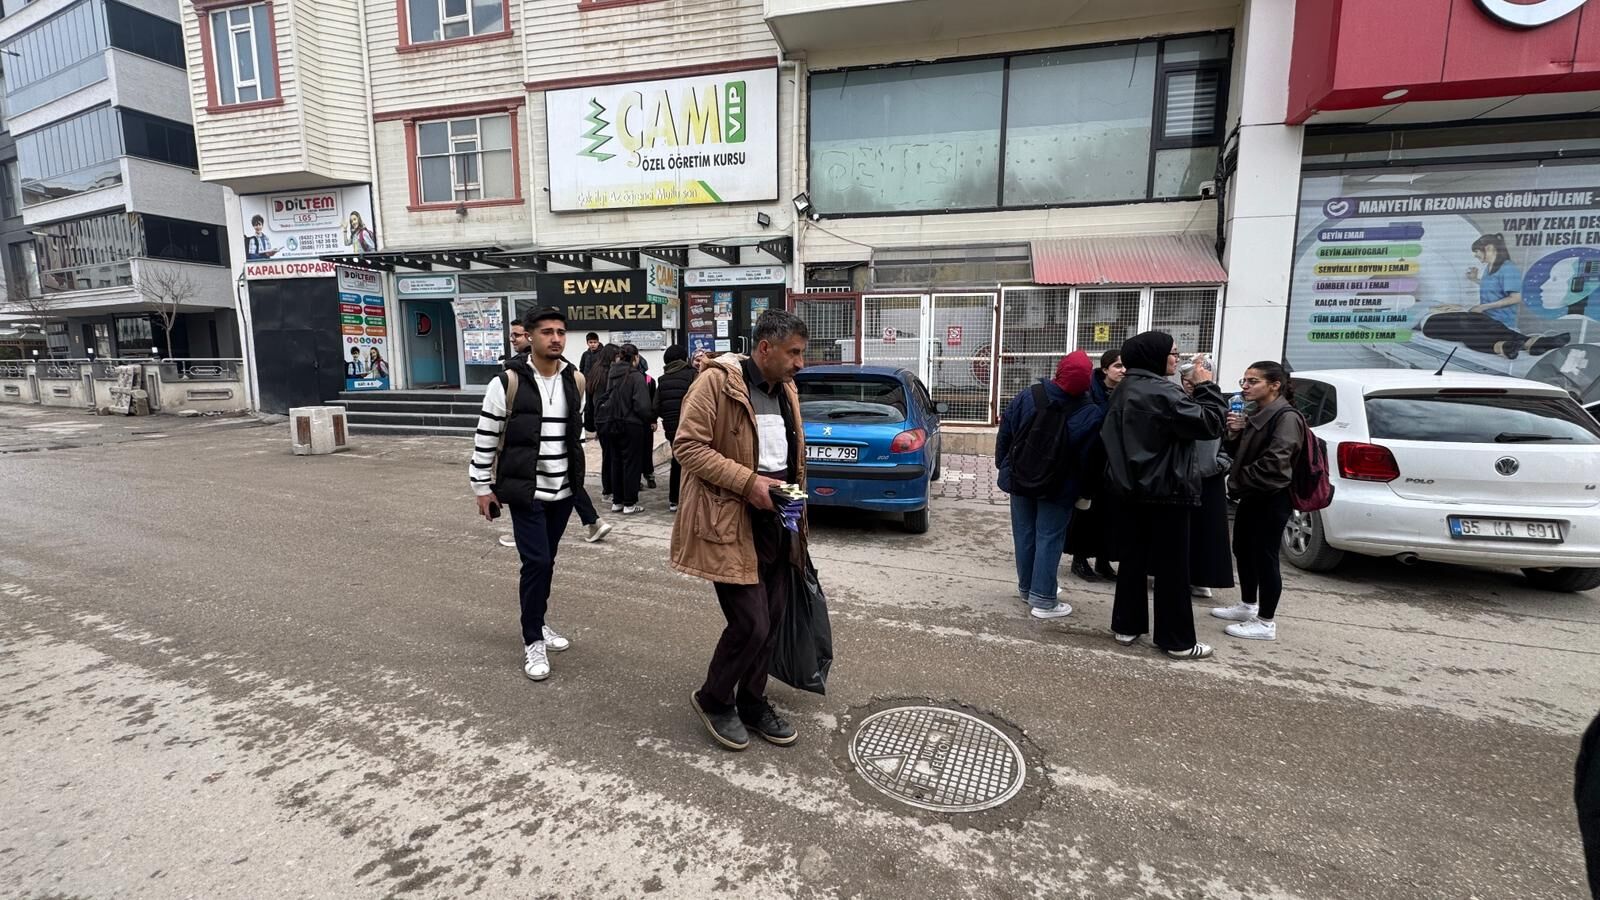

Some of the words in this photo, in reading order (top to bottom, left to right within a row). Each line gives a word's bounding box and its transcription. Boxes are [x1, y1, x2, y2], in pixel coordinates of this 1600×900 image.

[729, 86, 742, 138] VIP
[616, 84, 722, 168] ÇAM
[642, 156, 665, 171] ÖZEL
[668, 152, 710, 169] ÖĞRETİM
[713, 152, 746, 166] KURSU
[1358, 197, 1422, 214] MANYETİK
[1424, 195, 1491, 211] REZONANS
[1494, 190, 1591, 208] GÖRÜNTÜLEME
[1503, 217, 1541, 231] YAPAY
[1542, 216, 1576, 230] ZEKA
[1321, 232, 1343, 240] BEYİN
[1344, 231, 1365, 239] EMAR
[1515, 231, 1543, 246] YENİ
[1545, 230, 1582, 245] NESİL
[1320, 248, 1341, 257] BEYİN
[247, 265, 284, 276] KAPALI
[286, 262, 336, 274] OTOPARK
[1318, 265, 1352, 273] SERVİKAL
[563, 278, 631, 294] EVVAN
[1316, 282, 1345, 290] LOMBER
[1369, 281, 1389, 289] EMAR
[1315, 298, 1337, 307] KALÇA
[1349, 297, 1361, 306] DİZ
[1313, 315, 1329, 323] TÜM
[1345, 331, 1370, 339] GÖĞÜS
[817, 447, 832, 458] FC
[837, 447, 857, 459] 799
[1462, 520, 1480, 534] 65
